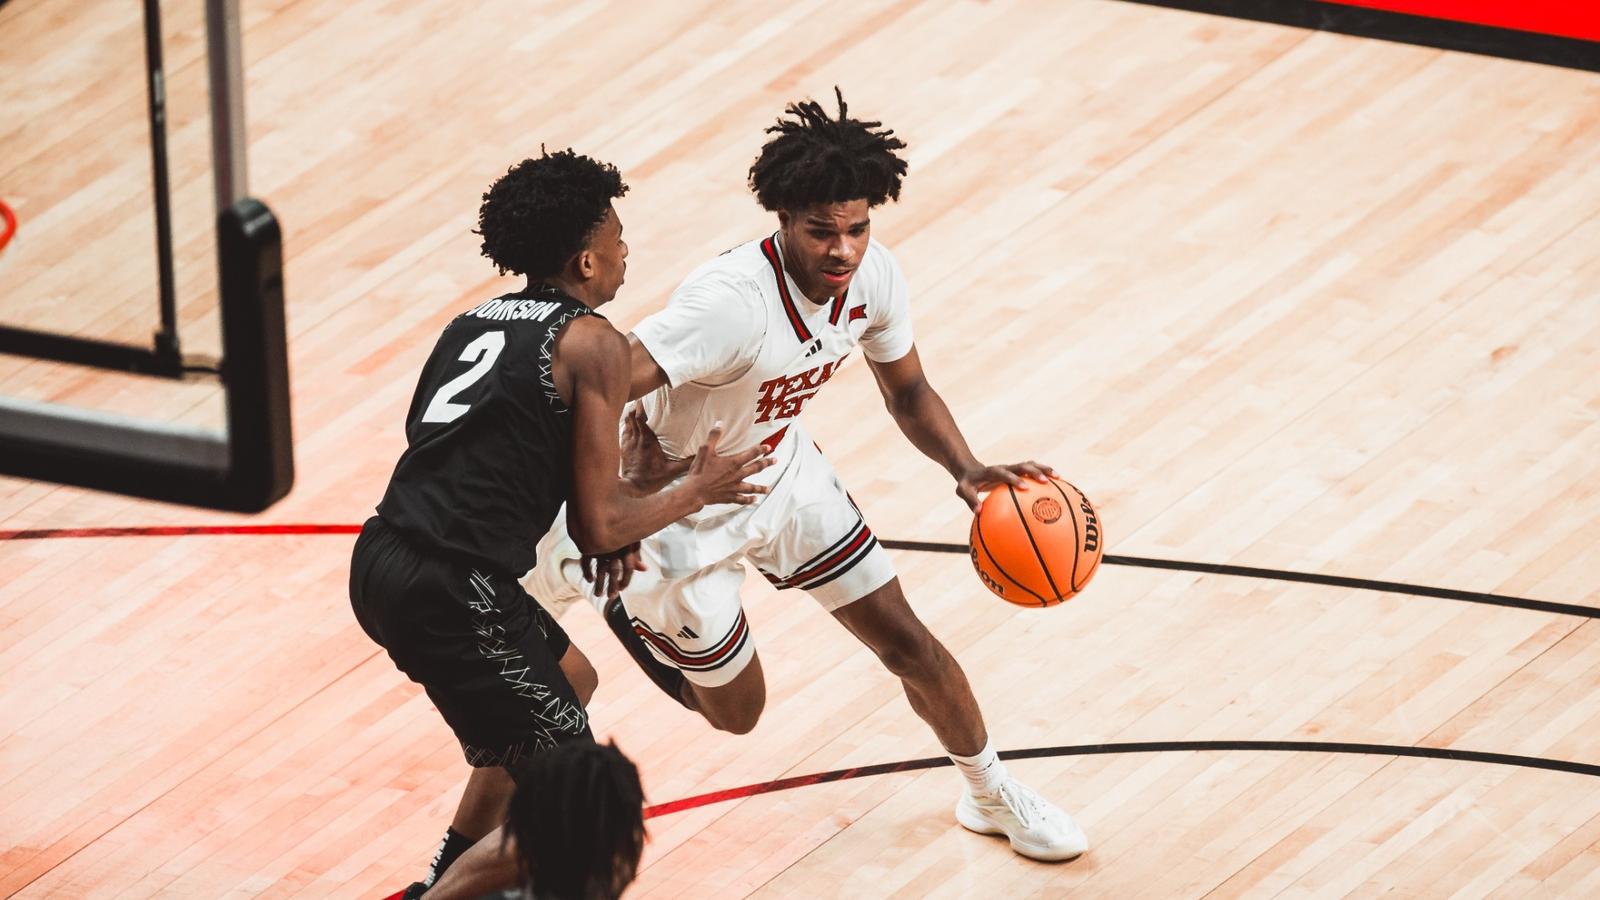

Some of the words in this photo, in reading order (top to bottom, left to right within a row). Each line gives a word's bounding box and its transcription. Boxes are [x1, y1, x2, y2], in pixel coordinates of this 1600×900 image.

[465, 299, 562, 322] JOHNSON
[422, 331, 506, 423] 2
[754, 387, 820, 424] TEC
